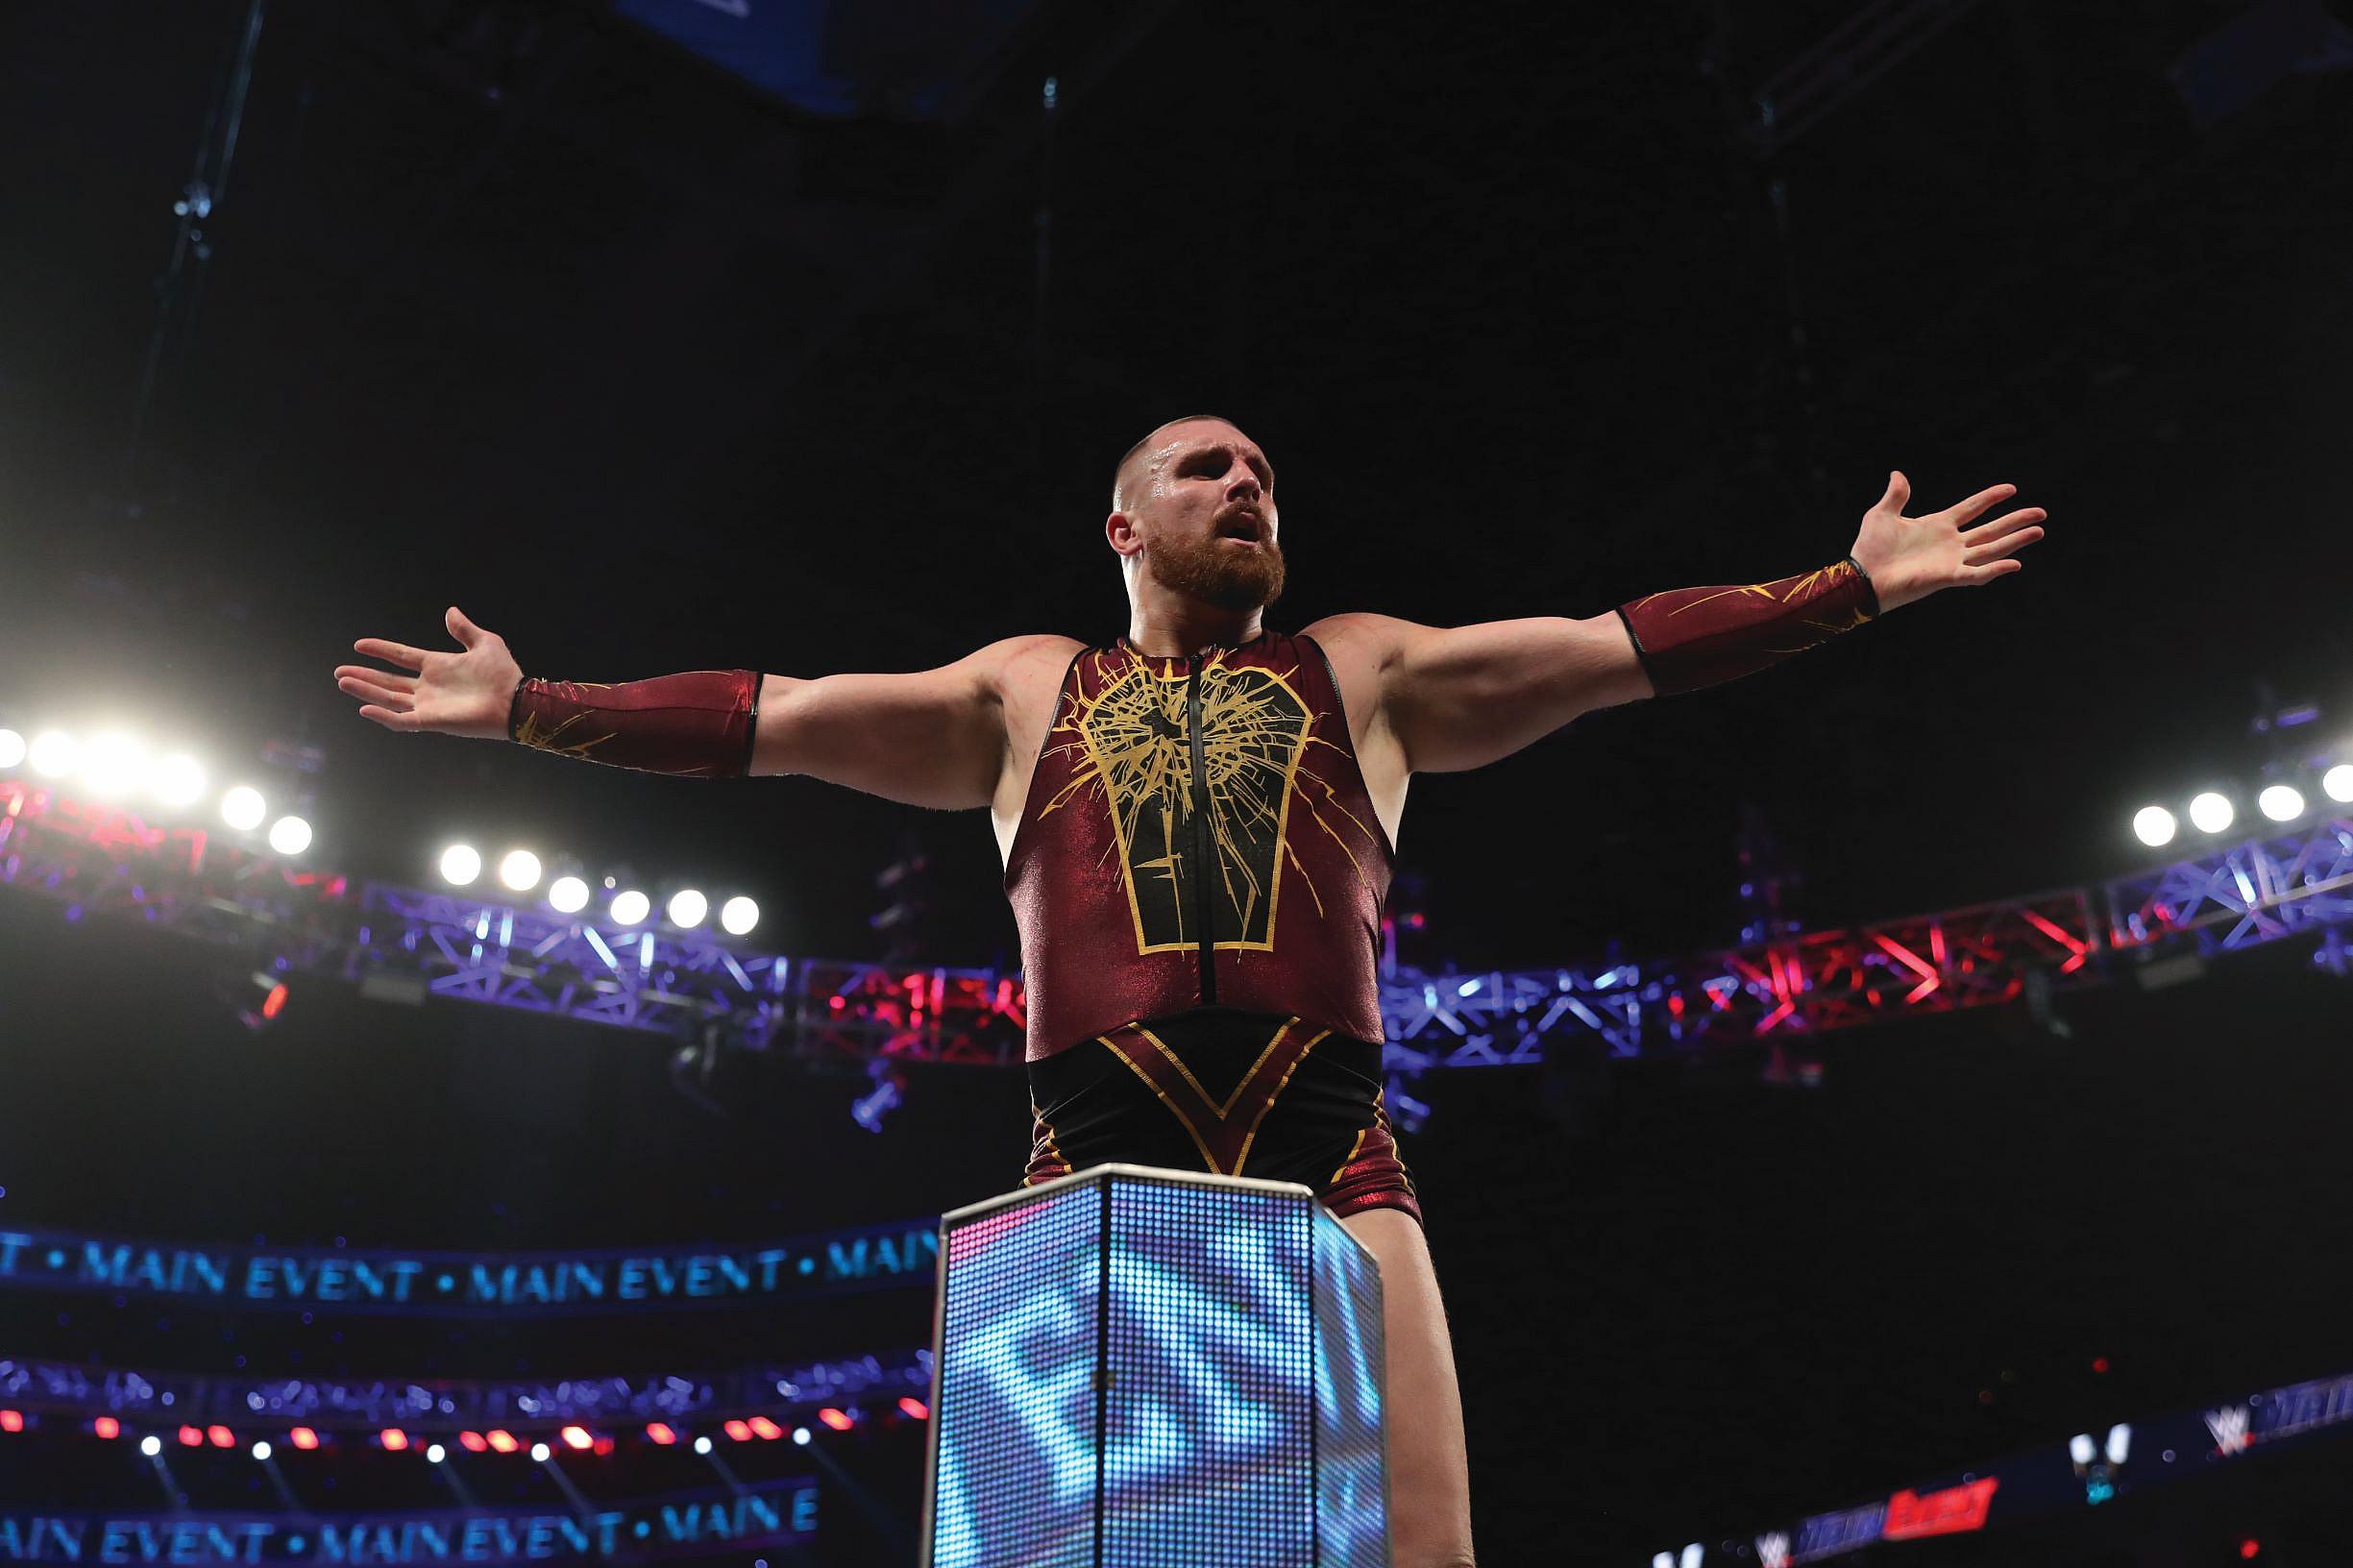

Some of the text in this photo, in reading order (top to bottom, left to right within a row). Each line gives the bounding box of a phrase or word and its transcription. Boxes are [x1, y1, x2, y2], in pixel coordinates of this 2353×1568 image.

[80, 1241, 228, 1293] MAIN
[244, 1253, 424, 1302] EVENT
[464, 1262, 606, 1305] MAIN
[618, 1250, 788, 1301] EVENT
[100, 1518, 276, 1564] EVENT
[315, 1520, 450, 1563] MAIN
[459, 1510, 624, 1562] EVENT
[661, 1493, 782, 1542] MAIN
